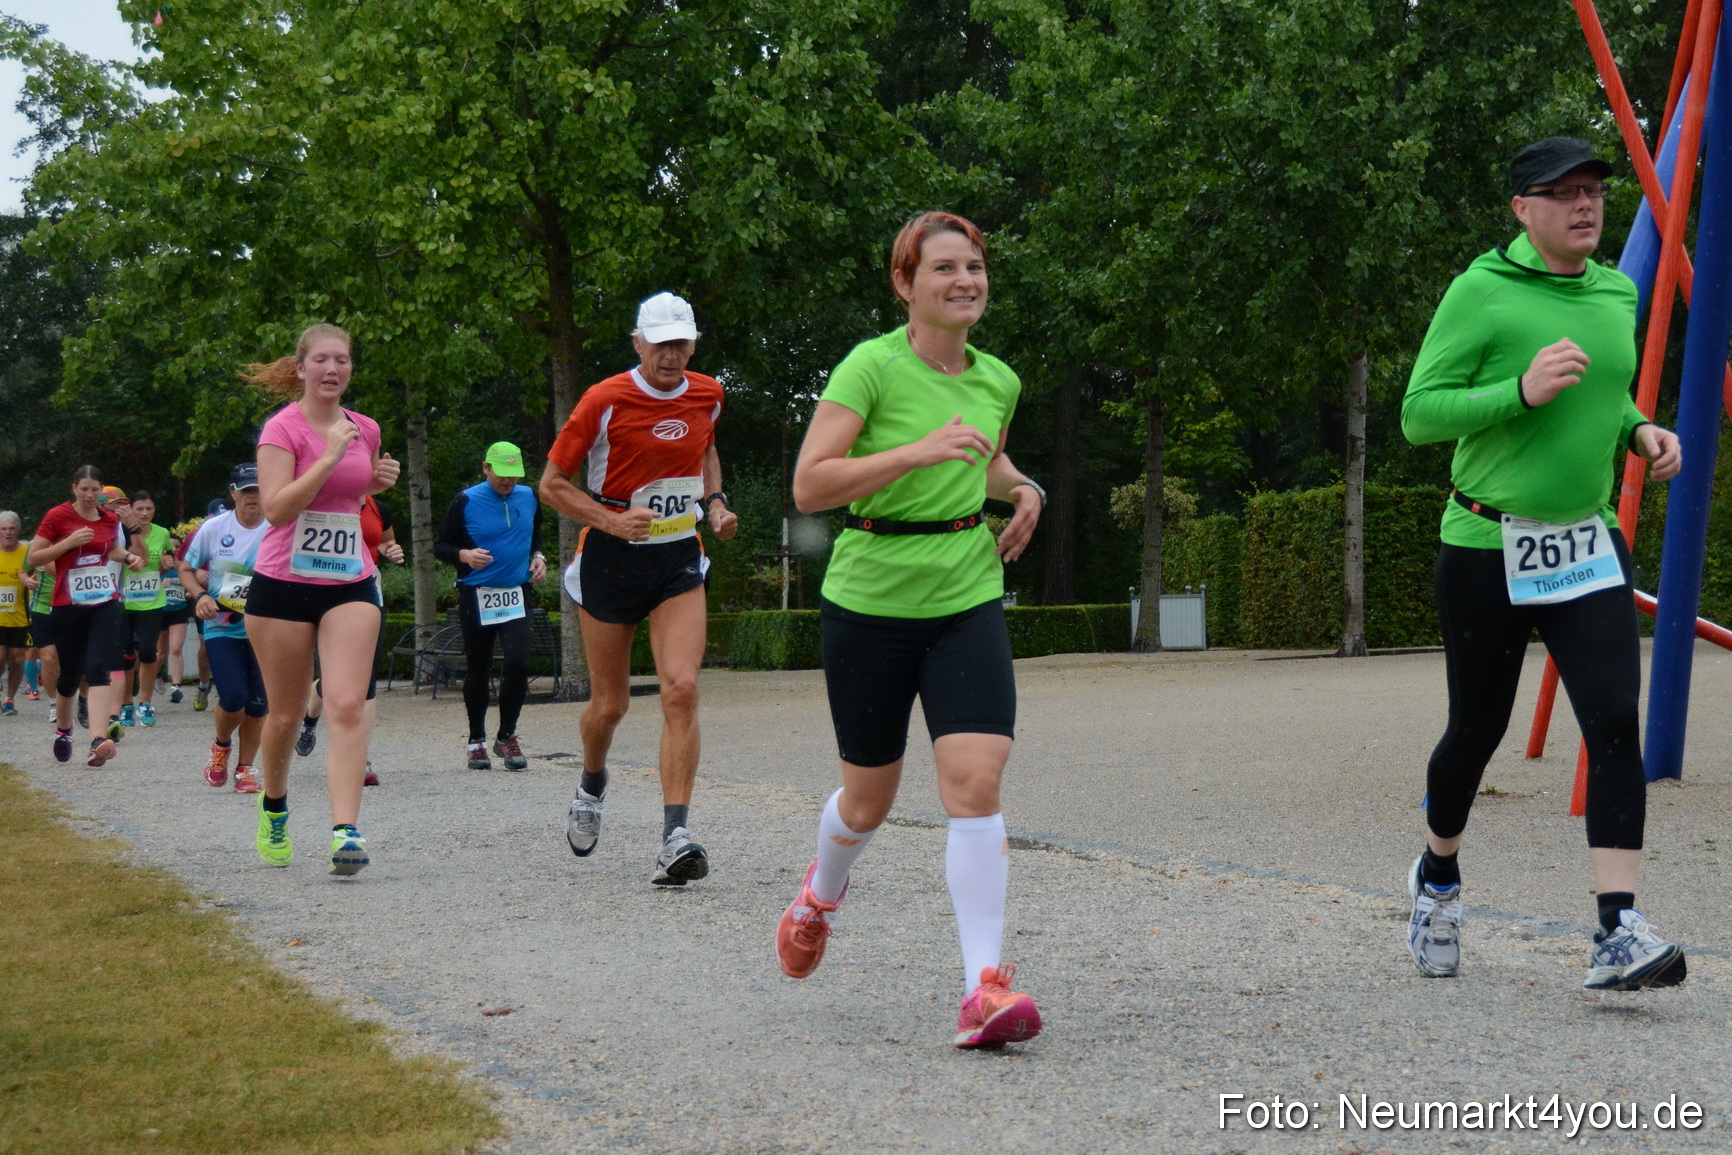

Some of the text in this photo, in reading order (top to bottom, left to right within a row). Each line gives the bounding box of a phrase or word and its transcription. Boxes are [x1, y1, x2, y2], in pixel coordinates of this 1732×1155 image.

[648, 495, 692, 517] 605
[650, 523, 678, 536] Martin
[301, 527, 356, 555] 2201
[1516, 525, 1597, 571] 2617
[312, 559, 347, 571] Marina
[74, 575, 109, 591] 2035
[130, 579, 158, 591] 2147
[1533, 568, 1595, 593] Thorsten
[1, 593, 14, 602] 30
[483, 591, 519, 608] 2308
